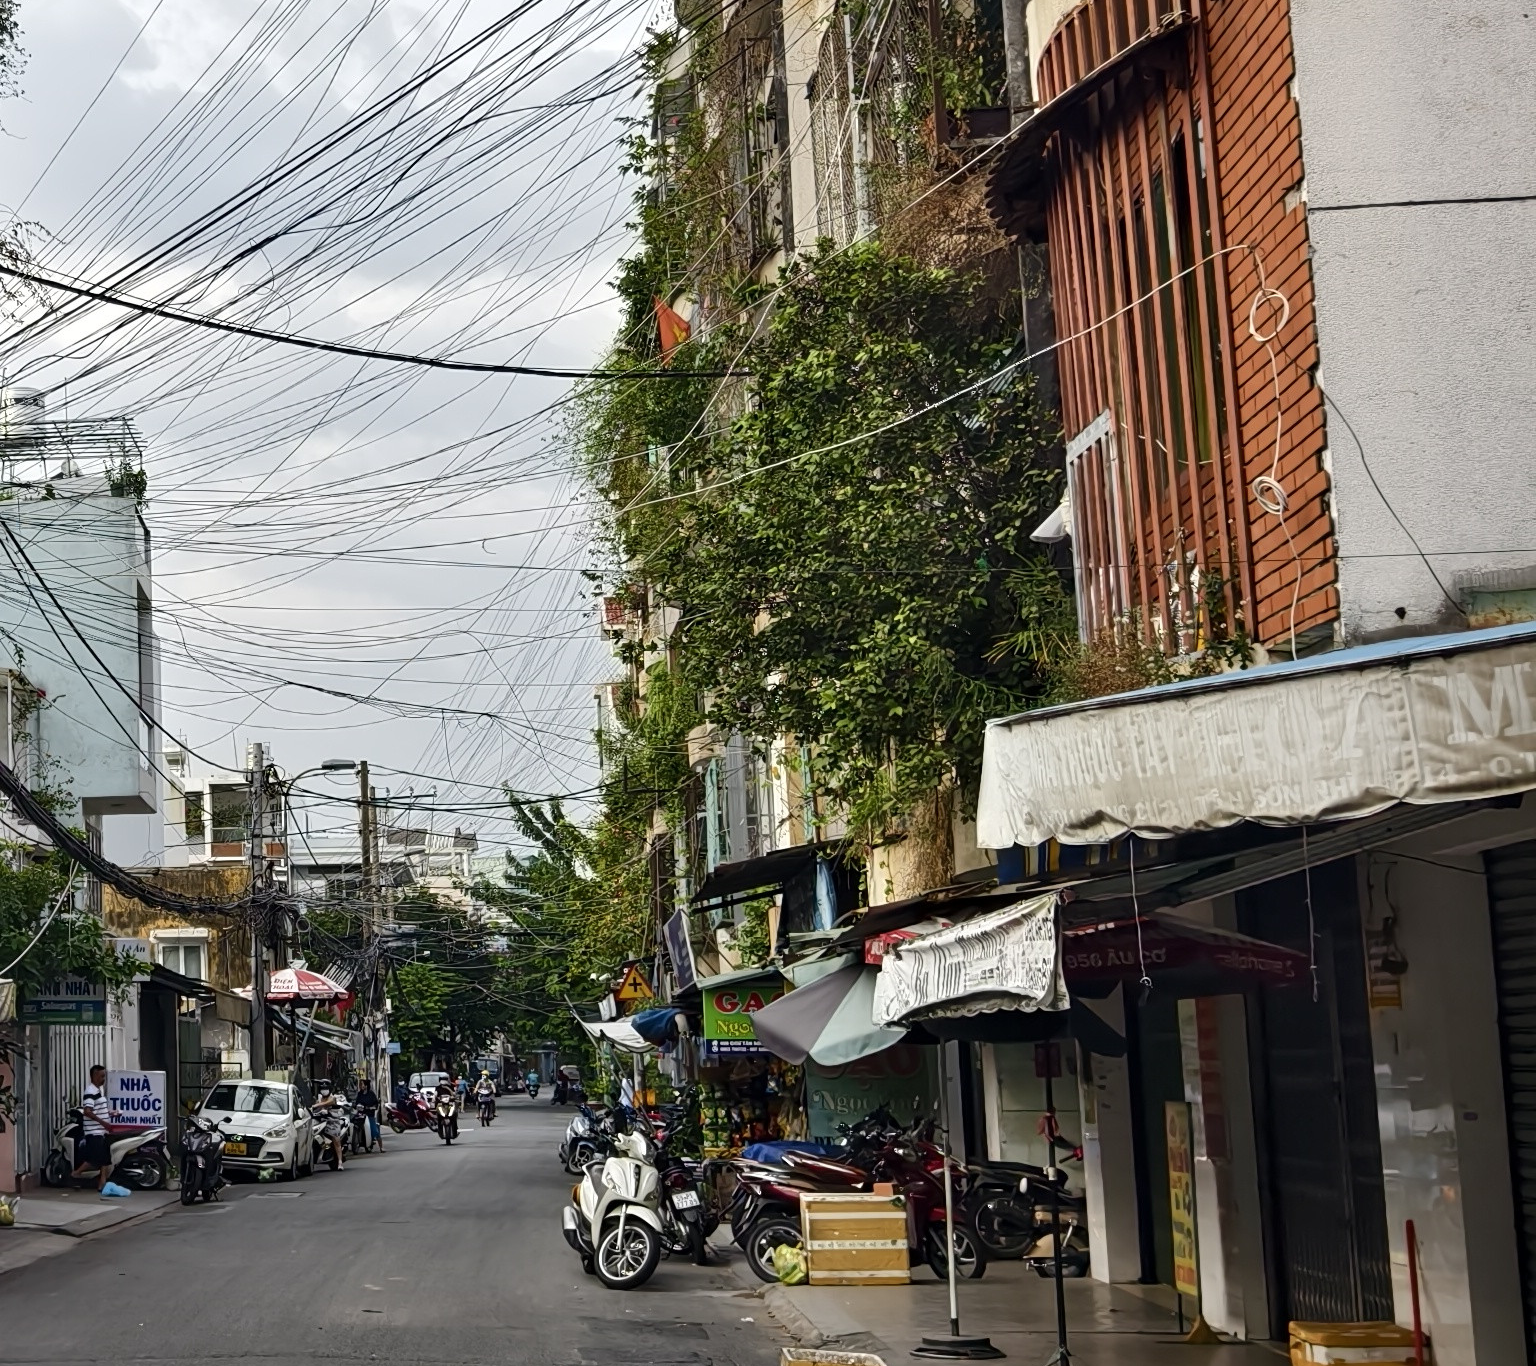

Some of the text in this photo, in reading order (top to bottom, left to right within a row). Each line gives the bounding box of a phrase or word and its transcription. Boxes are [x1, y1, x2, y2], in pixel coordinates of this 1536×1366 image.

[120, 1075, 151, 1092] NHÀ
[110, 1093, 162, 1112] THUỐC
[139, 1114, 162, 1125] NHẤT
